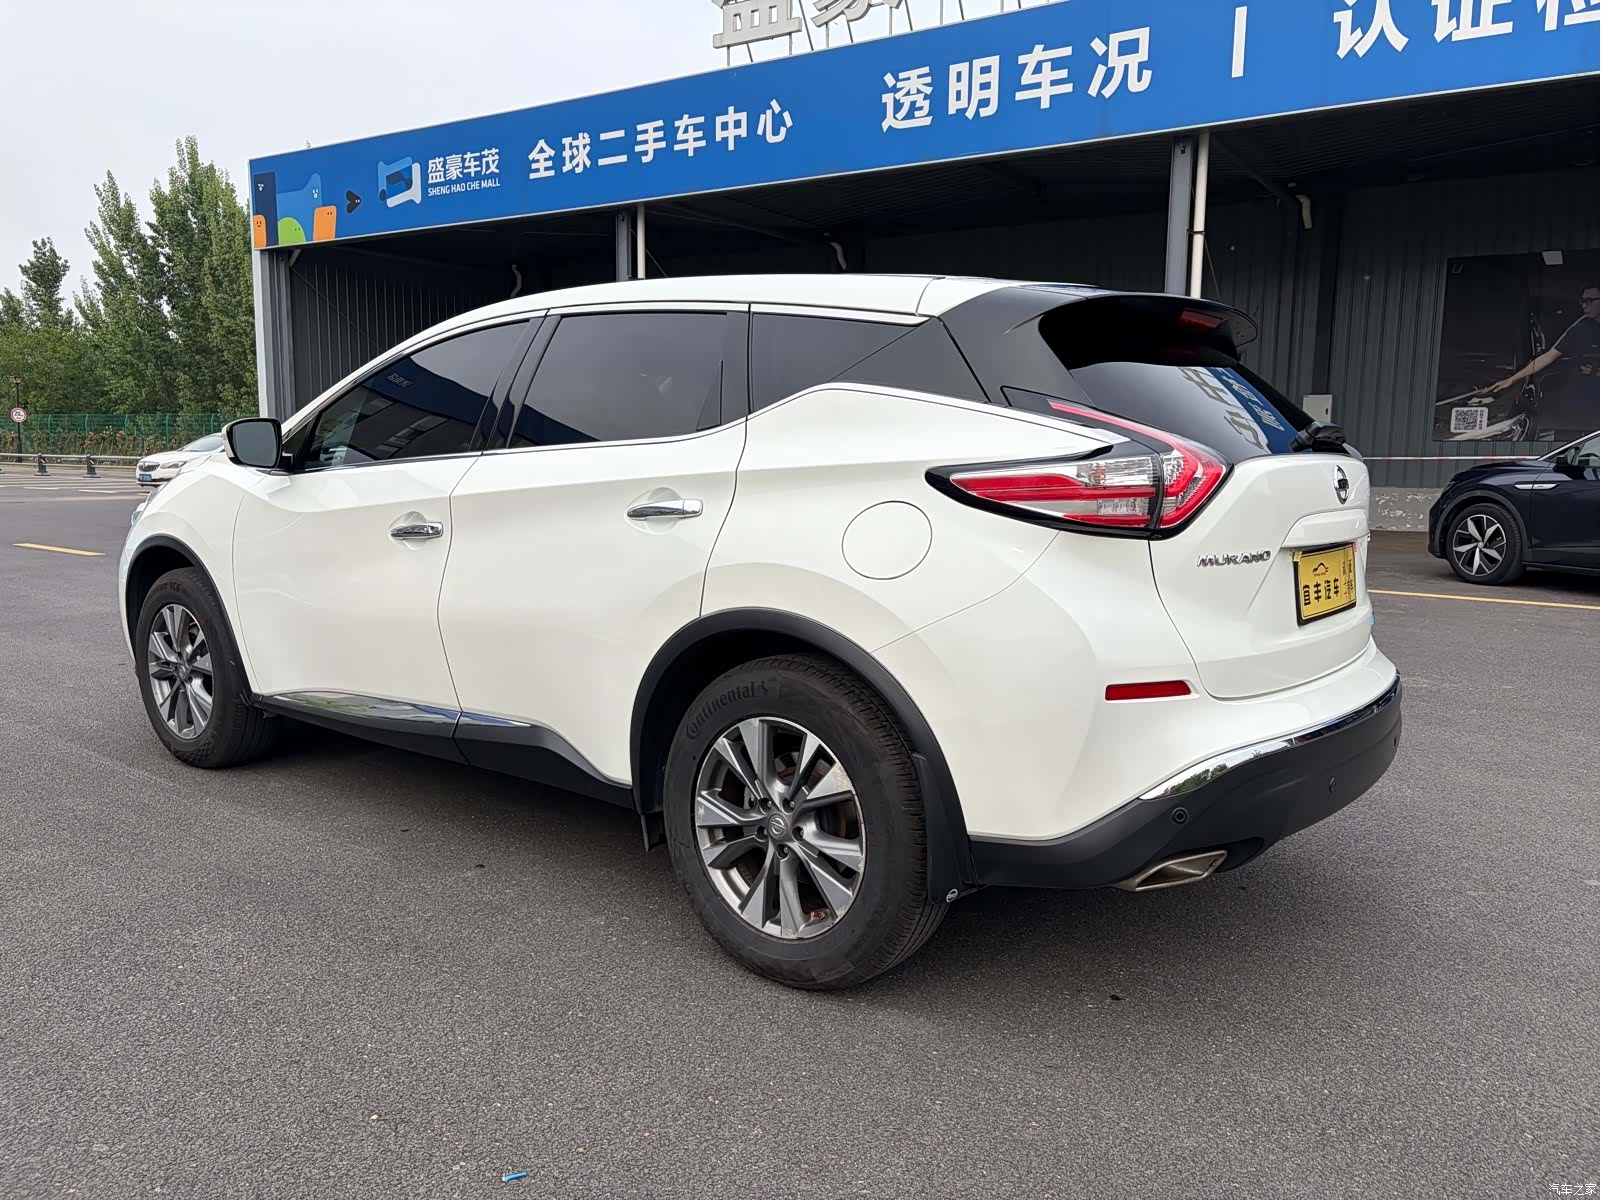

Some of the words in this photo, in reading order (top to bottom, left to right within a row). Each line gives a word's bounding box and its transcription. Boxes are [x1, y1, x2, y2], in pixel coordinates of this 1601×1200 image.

[528, 99, 794, 180] 全球二手车中心
[880, 26, 1153, 133] 透明车况
[427, 148, 500, 184] 盛豪车茂
[427, 185, 450, 197] SHENG
[451, 182, 466, 193] HAO
[466, 180, 480, 191] CHE
[481, 177, 501, 189] MALL
[1197, 550, 1271, 568] MURANO
[686, 680, 756, 740] Continental
